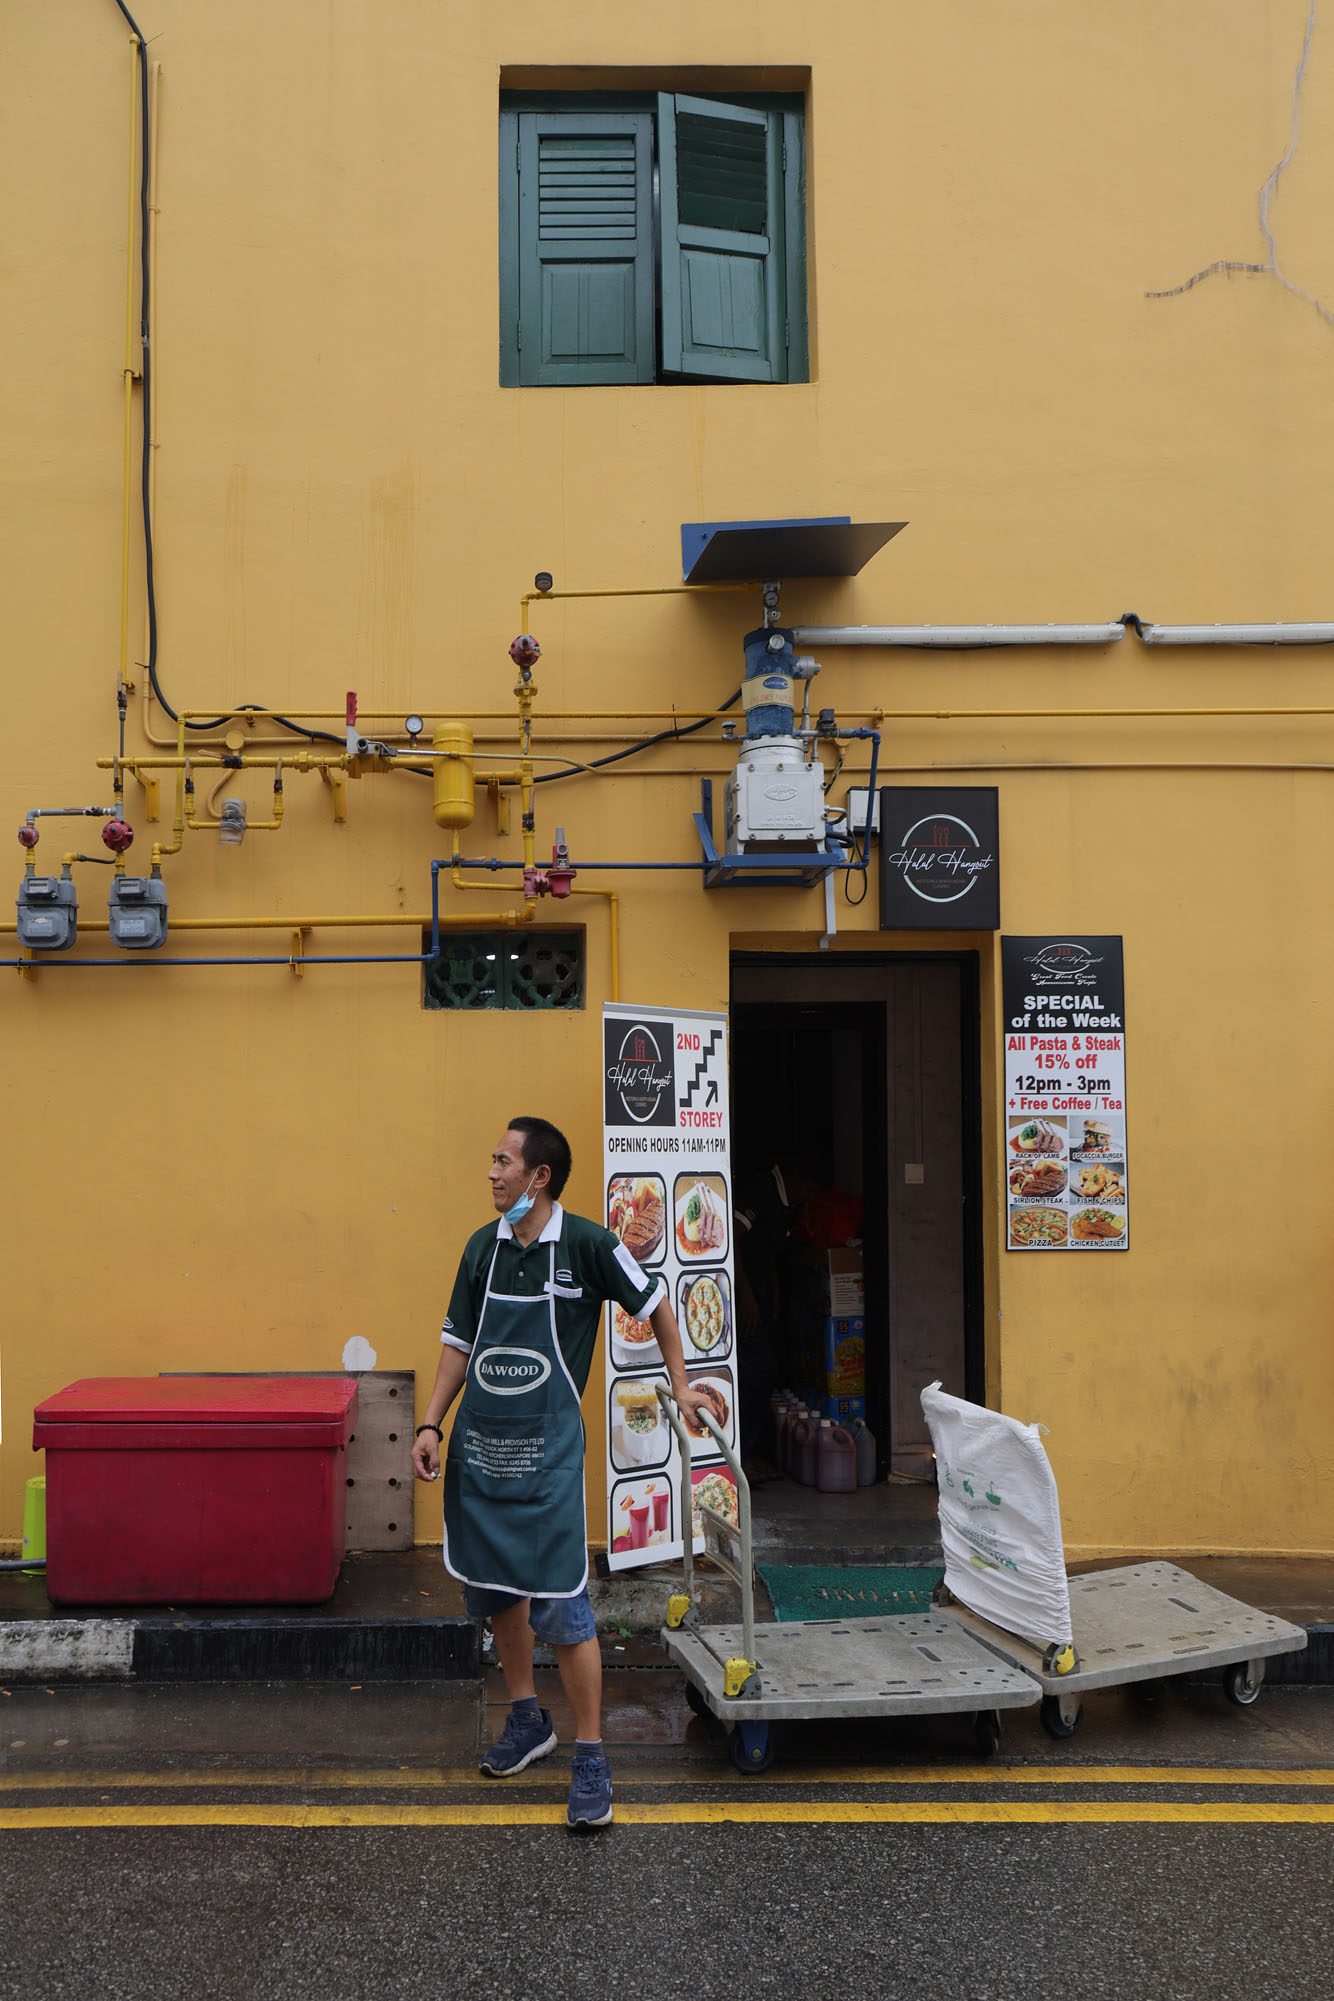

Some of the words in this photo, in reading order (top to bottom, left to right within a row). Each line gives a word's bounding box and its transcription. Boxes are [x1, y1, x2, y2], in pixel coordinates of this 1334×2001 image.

[889, 848, 936, 874] Halal
[1024, 996, 1104, 1010] SPECIAL
[1011, 1013, 1031, 1028] of
[1036, 1013, 1067, 1028] the
[1072, 1013, 1121, 1028] Week
[677, 1033, 700, 1050] 2ND
[1008, 1036, 1025, 1050] All
[1030, 1036, 1067, 1050] Pasta
[1072, 1036, 1081, 1050] &
[1085, 1036, 1120, 1050] Steak
[1035, 1054, 1070, 1069] 15%
[1075, 1054, 1097, 1069] off
[607, 1062, 637, 1091] Halal
[1015, 1075, 1061, 1094] 12pm
[1077, 1075, 1110, 1094] 3pm
[1020, 1097, 1048, 1110] Free
[1052, 1097, 1091, 1110] Coffee
[1102, 1097, 1122, 1110] Tea
[680, 1111, 723, 1127] STOREY
[608, 1138, 648, 1152] OPENING
[650, 1138, 679, 1152] HOURS
[682, 1138, 726, 1152] 11AM-11PM
[481, 1363, 539, 1376] DAWOOD
